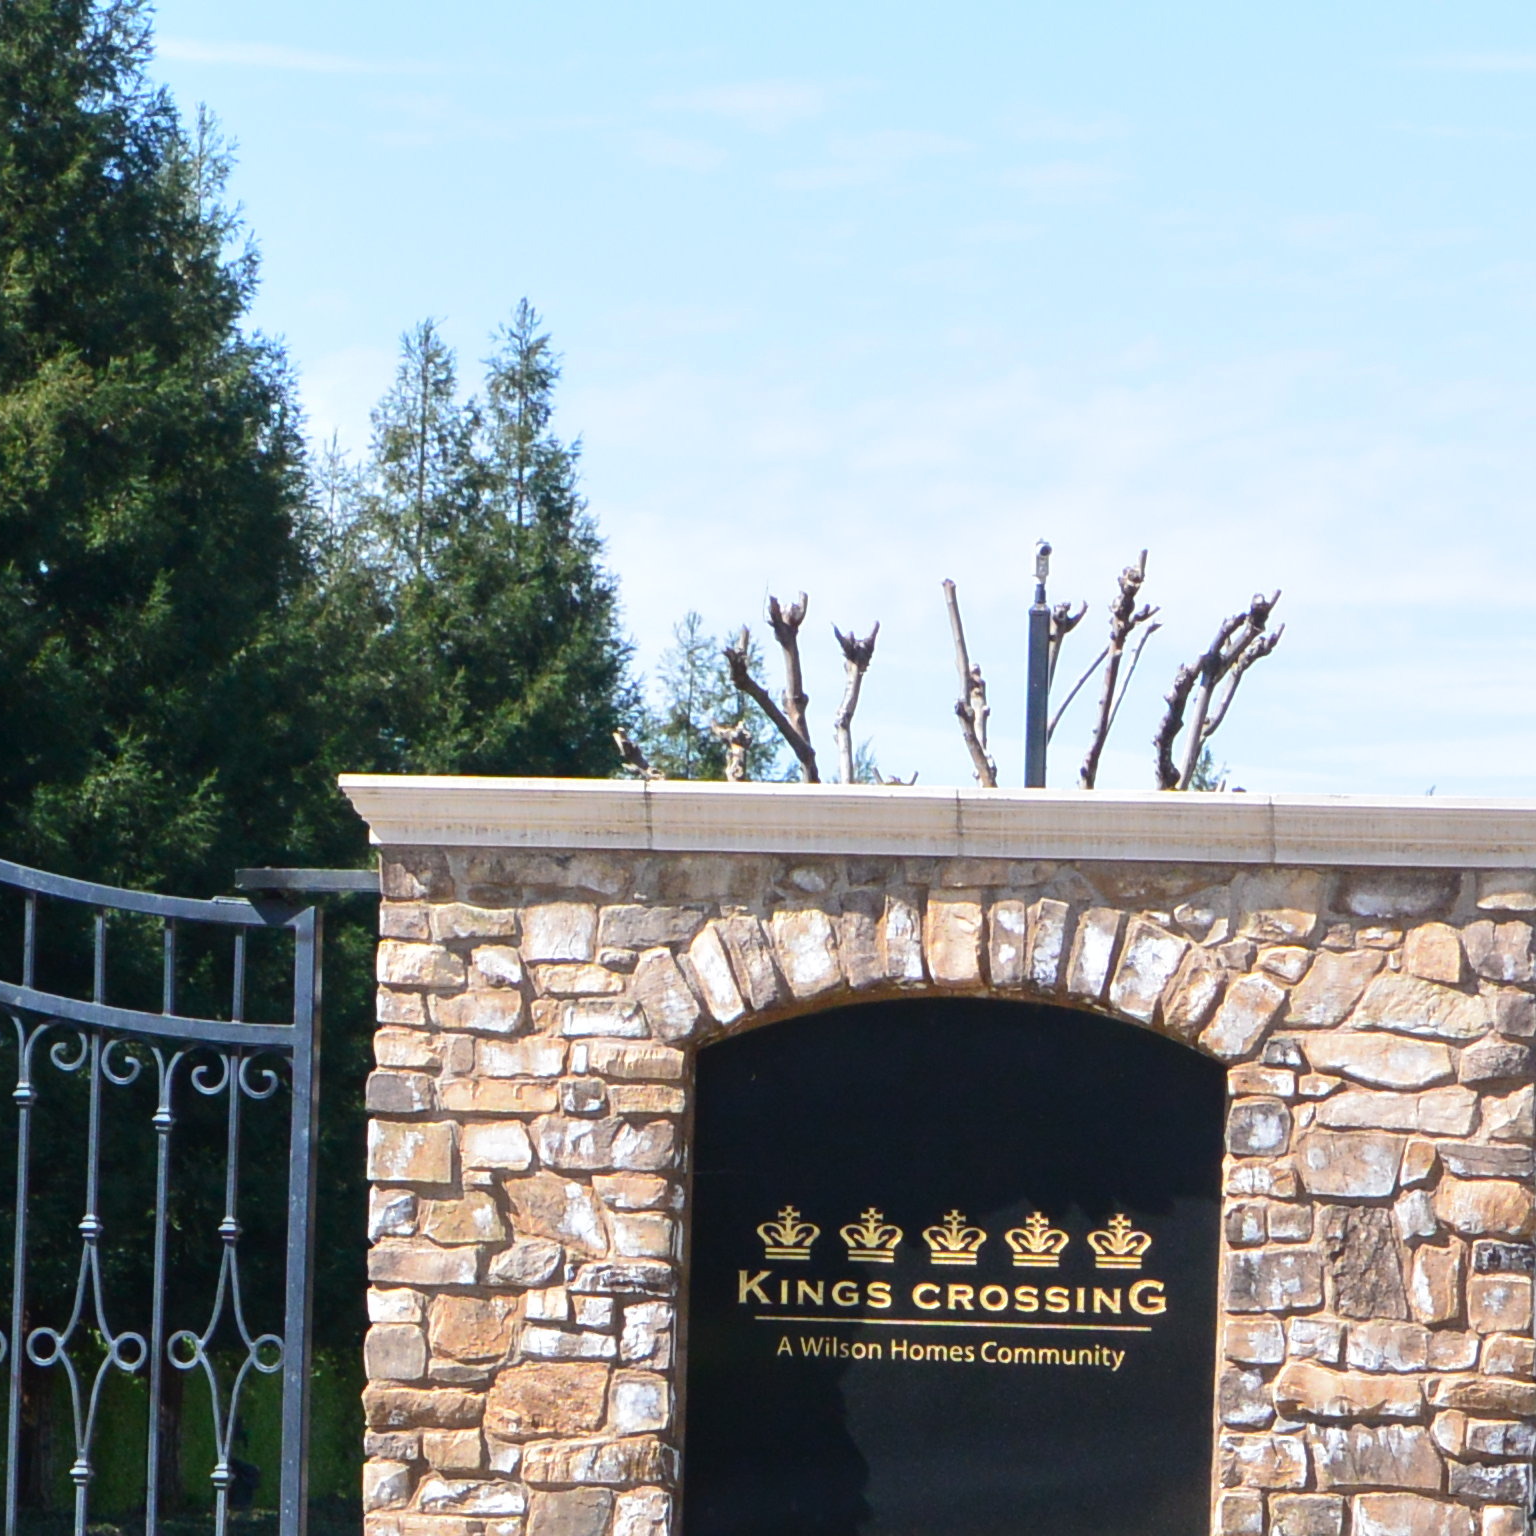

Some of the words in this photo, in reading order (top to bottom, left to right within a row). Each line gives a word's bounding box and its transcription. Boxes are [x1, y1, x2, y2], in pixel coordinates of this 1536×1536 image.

[737, 1269, 892, 1309] KINGS
[911, 1279, 1167, 1316] CROSSING
[776, 1336, 793, 1357] A
[800, 1336, 883, 1361] Wilson
[891, 1338, 976, 1363] Homes
[980, 1341, 1126, 1372] Community
